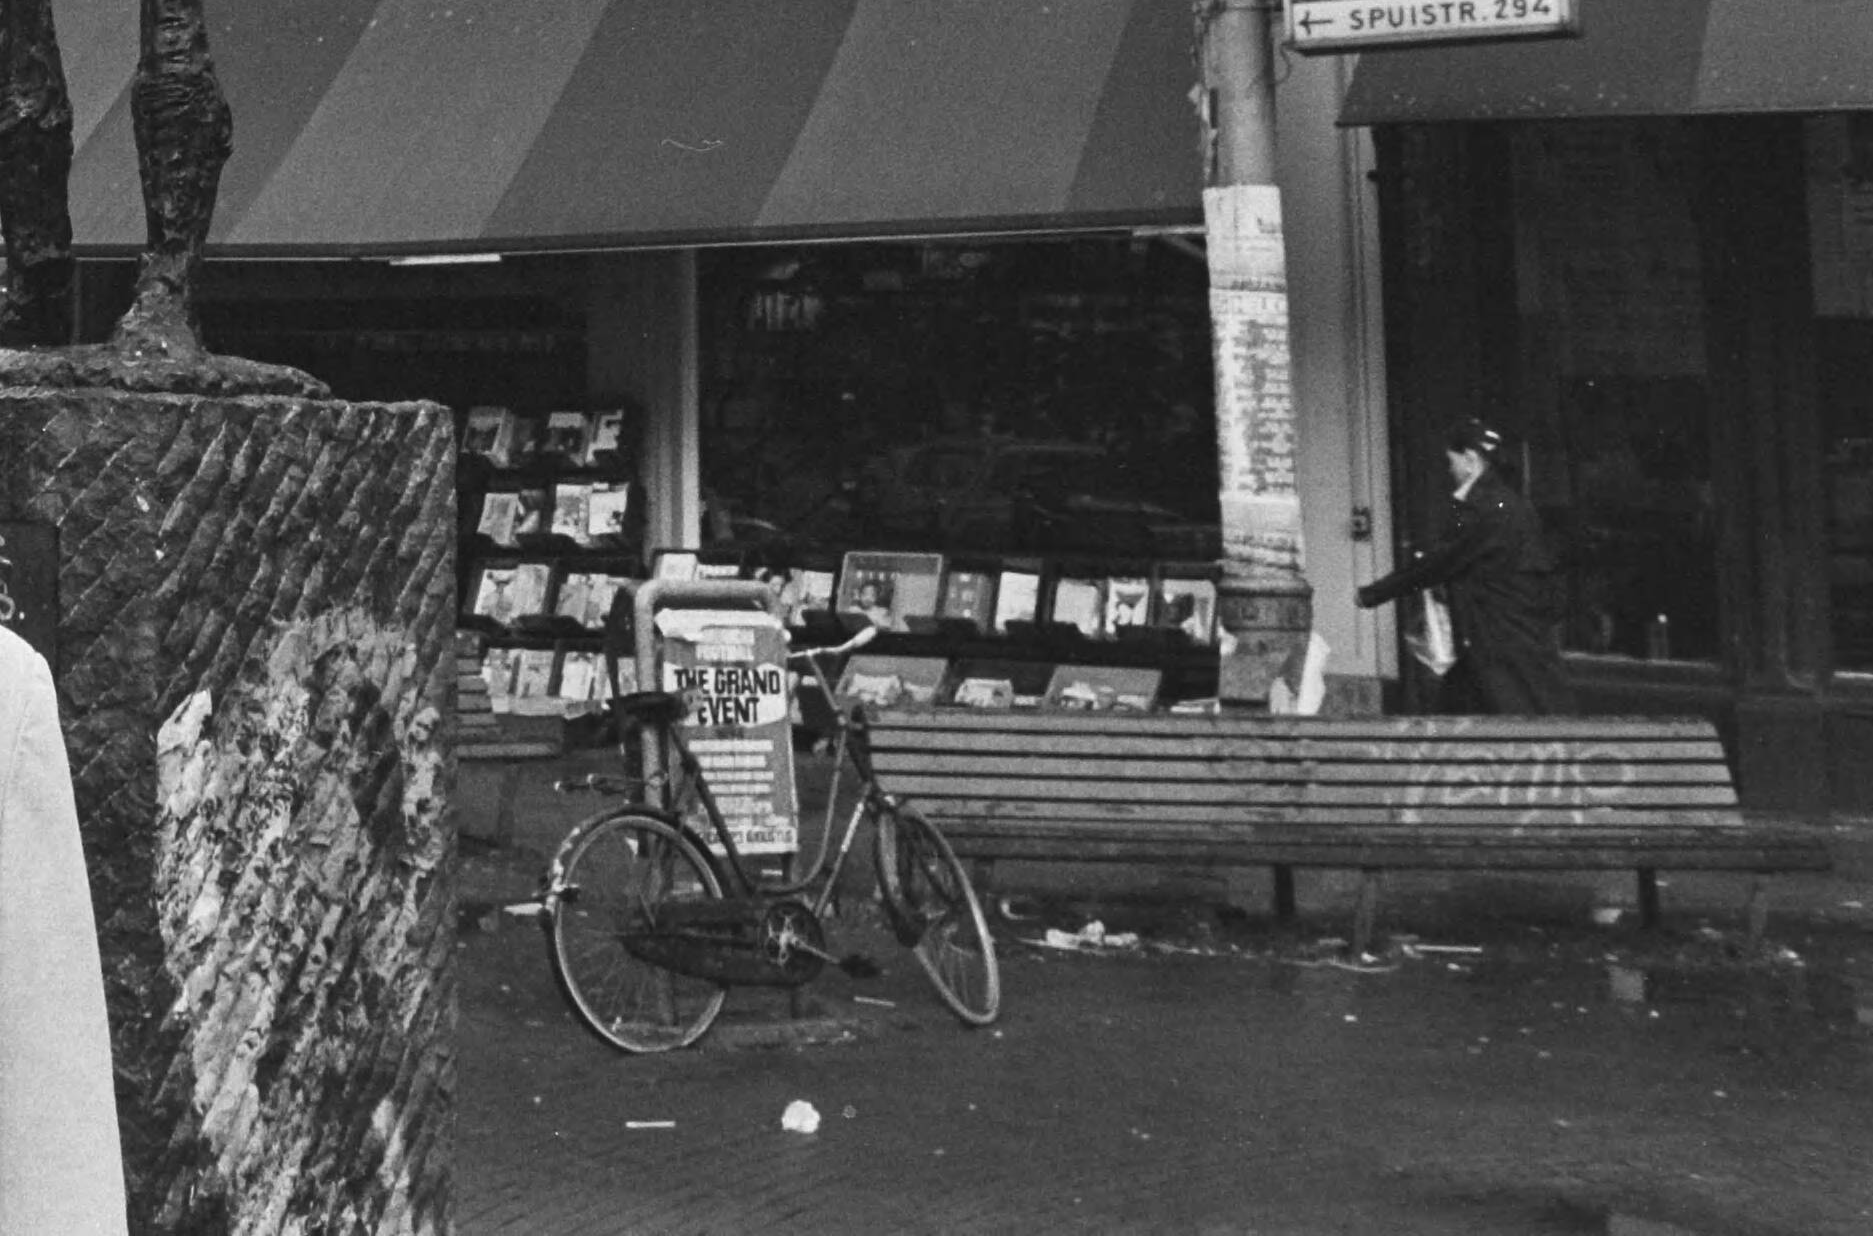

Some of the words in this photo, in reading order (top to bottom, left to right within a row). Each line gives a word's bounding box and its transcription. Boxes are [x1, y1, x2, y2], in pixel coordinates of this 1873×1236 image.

[1349, 1, 1488, 30] SPUISTR.
[674, 668, 708, 695] THE
[714, 668, 781, 695] GRAND
[697, 696, 760, 725] EVENT
